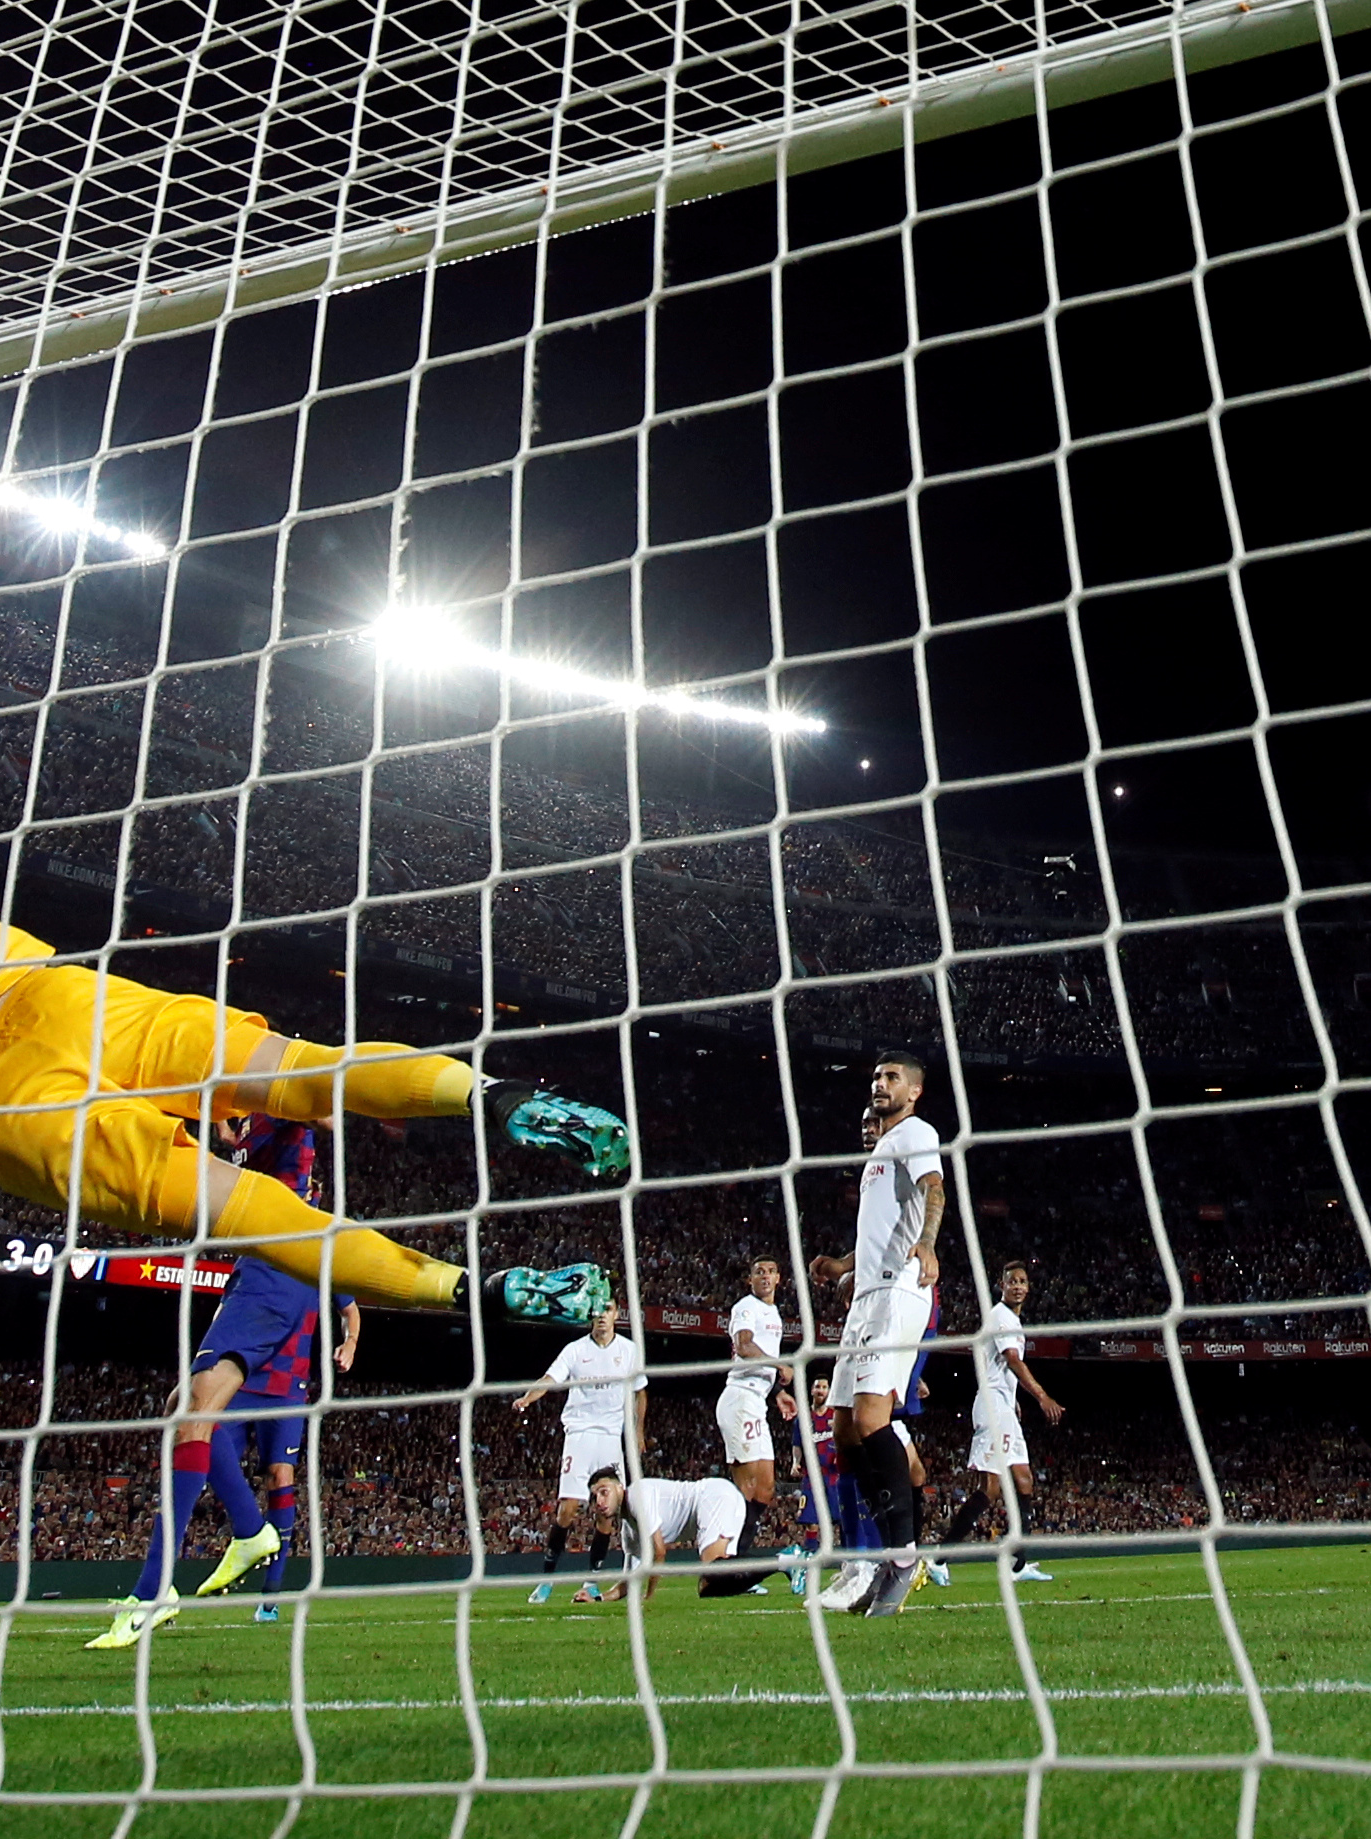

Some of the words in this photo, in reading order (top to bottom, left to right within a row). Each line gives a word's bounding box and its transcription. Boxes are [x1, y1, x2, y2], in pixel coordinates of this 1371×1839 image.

[3, 1239, 53, 1275] 3-0
[156, 1266, 212, 1287] ESTRLLA
[662, 1310, 701, 1326] Rakuten
[1204, 1342, 1245, 1354] Rakuten
[1263, 1342, 1306, 1354] Rakuten
[1325, 1341, 1368, 1353] Rakuten
[743, 1419, 762, 1440] 20
